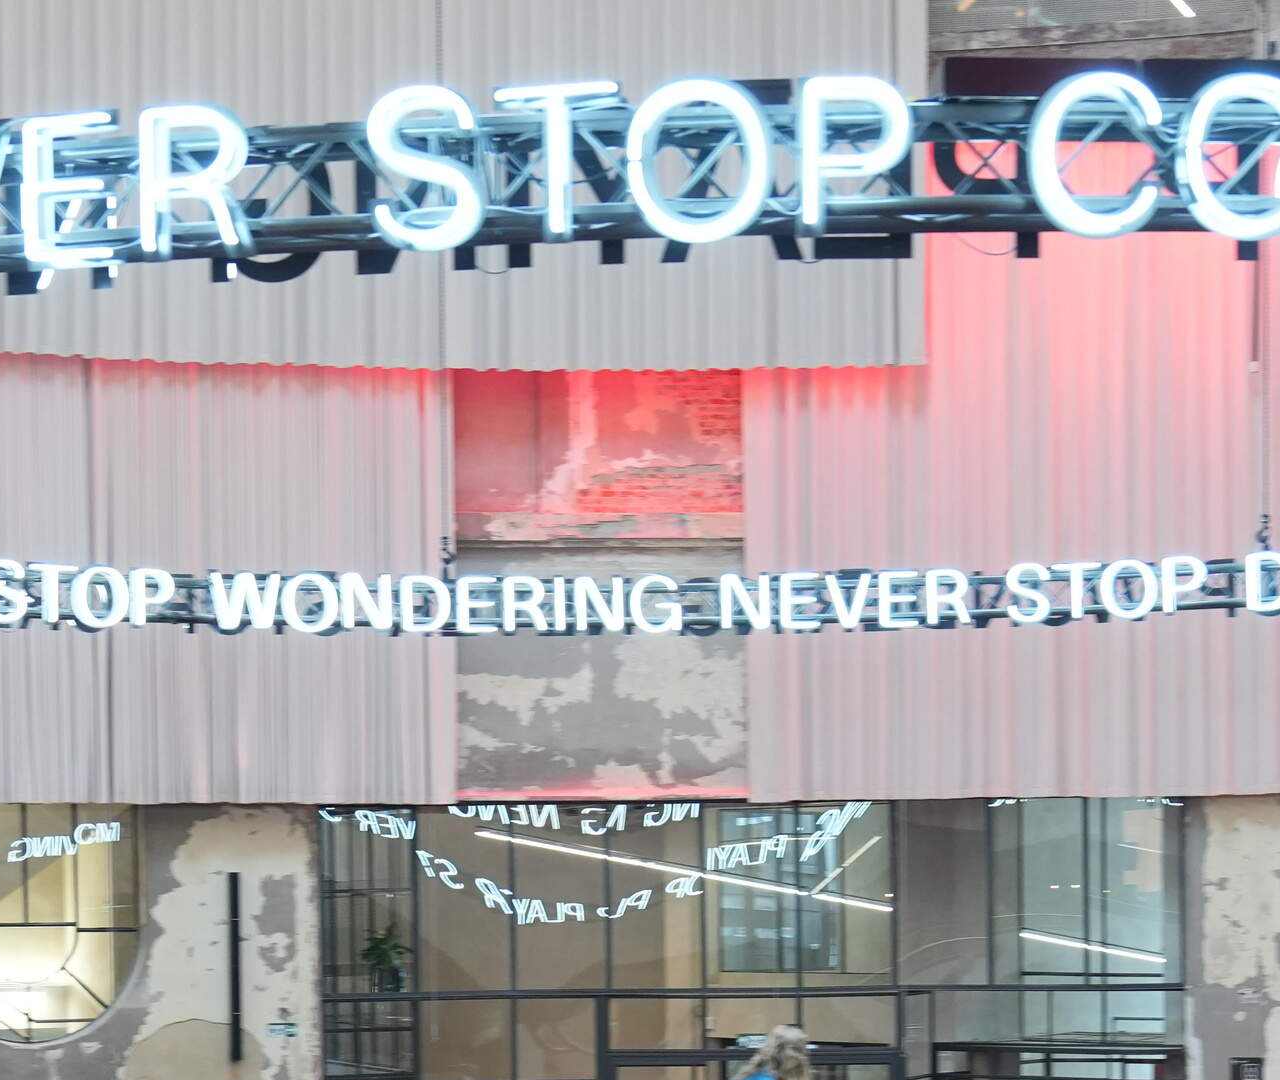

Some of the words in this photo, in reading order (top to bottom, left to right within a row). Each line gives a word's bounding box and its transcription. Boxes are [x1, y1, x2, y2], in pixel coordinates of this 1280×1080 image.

[366, 76, 913, 251] STOP
[210, 571, 682, 634] WONDERING
[720, 568, 971, 631] NEVER
[1005, 555, 1208, 624] STOP
